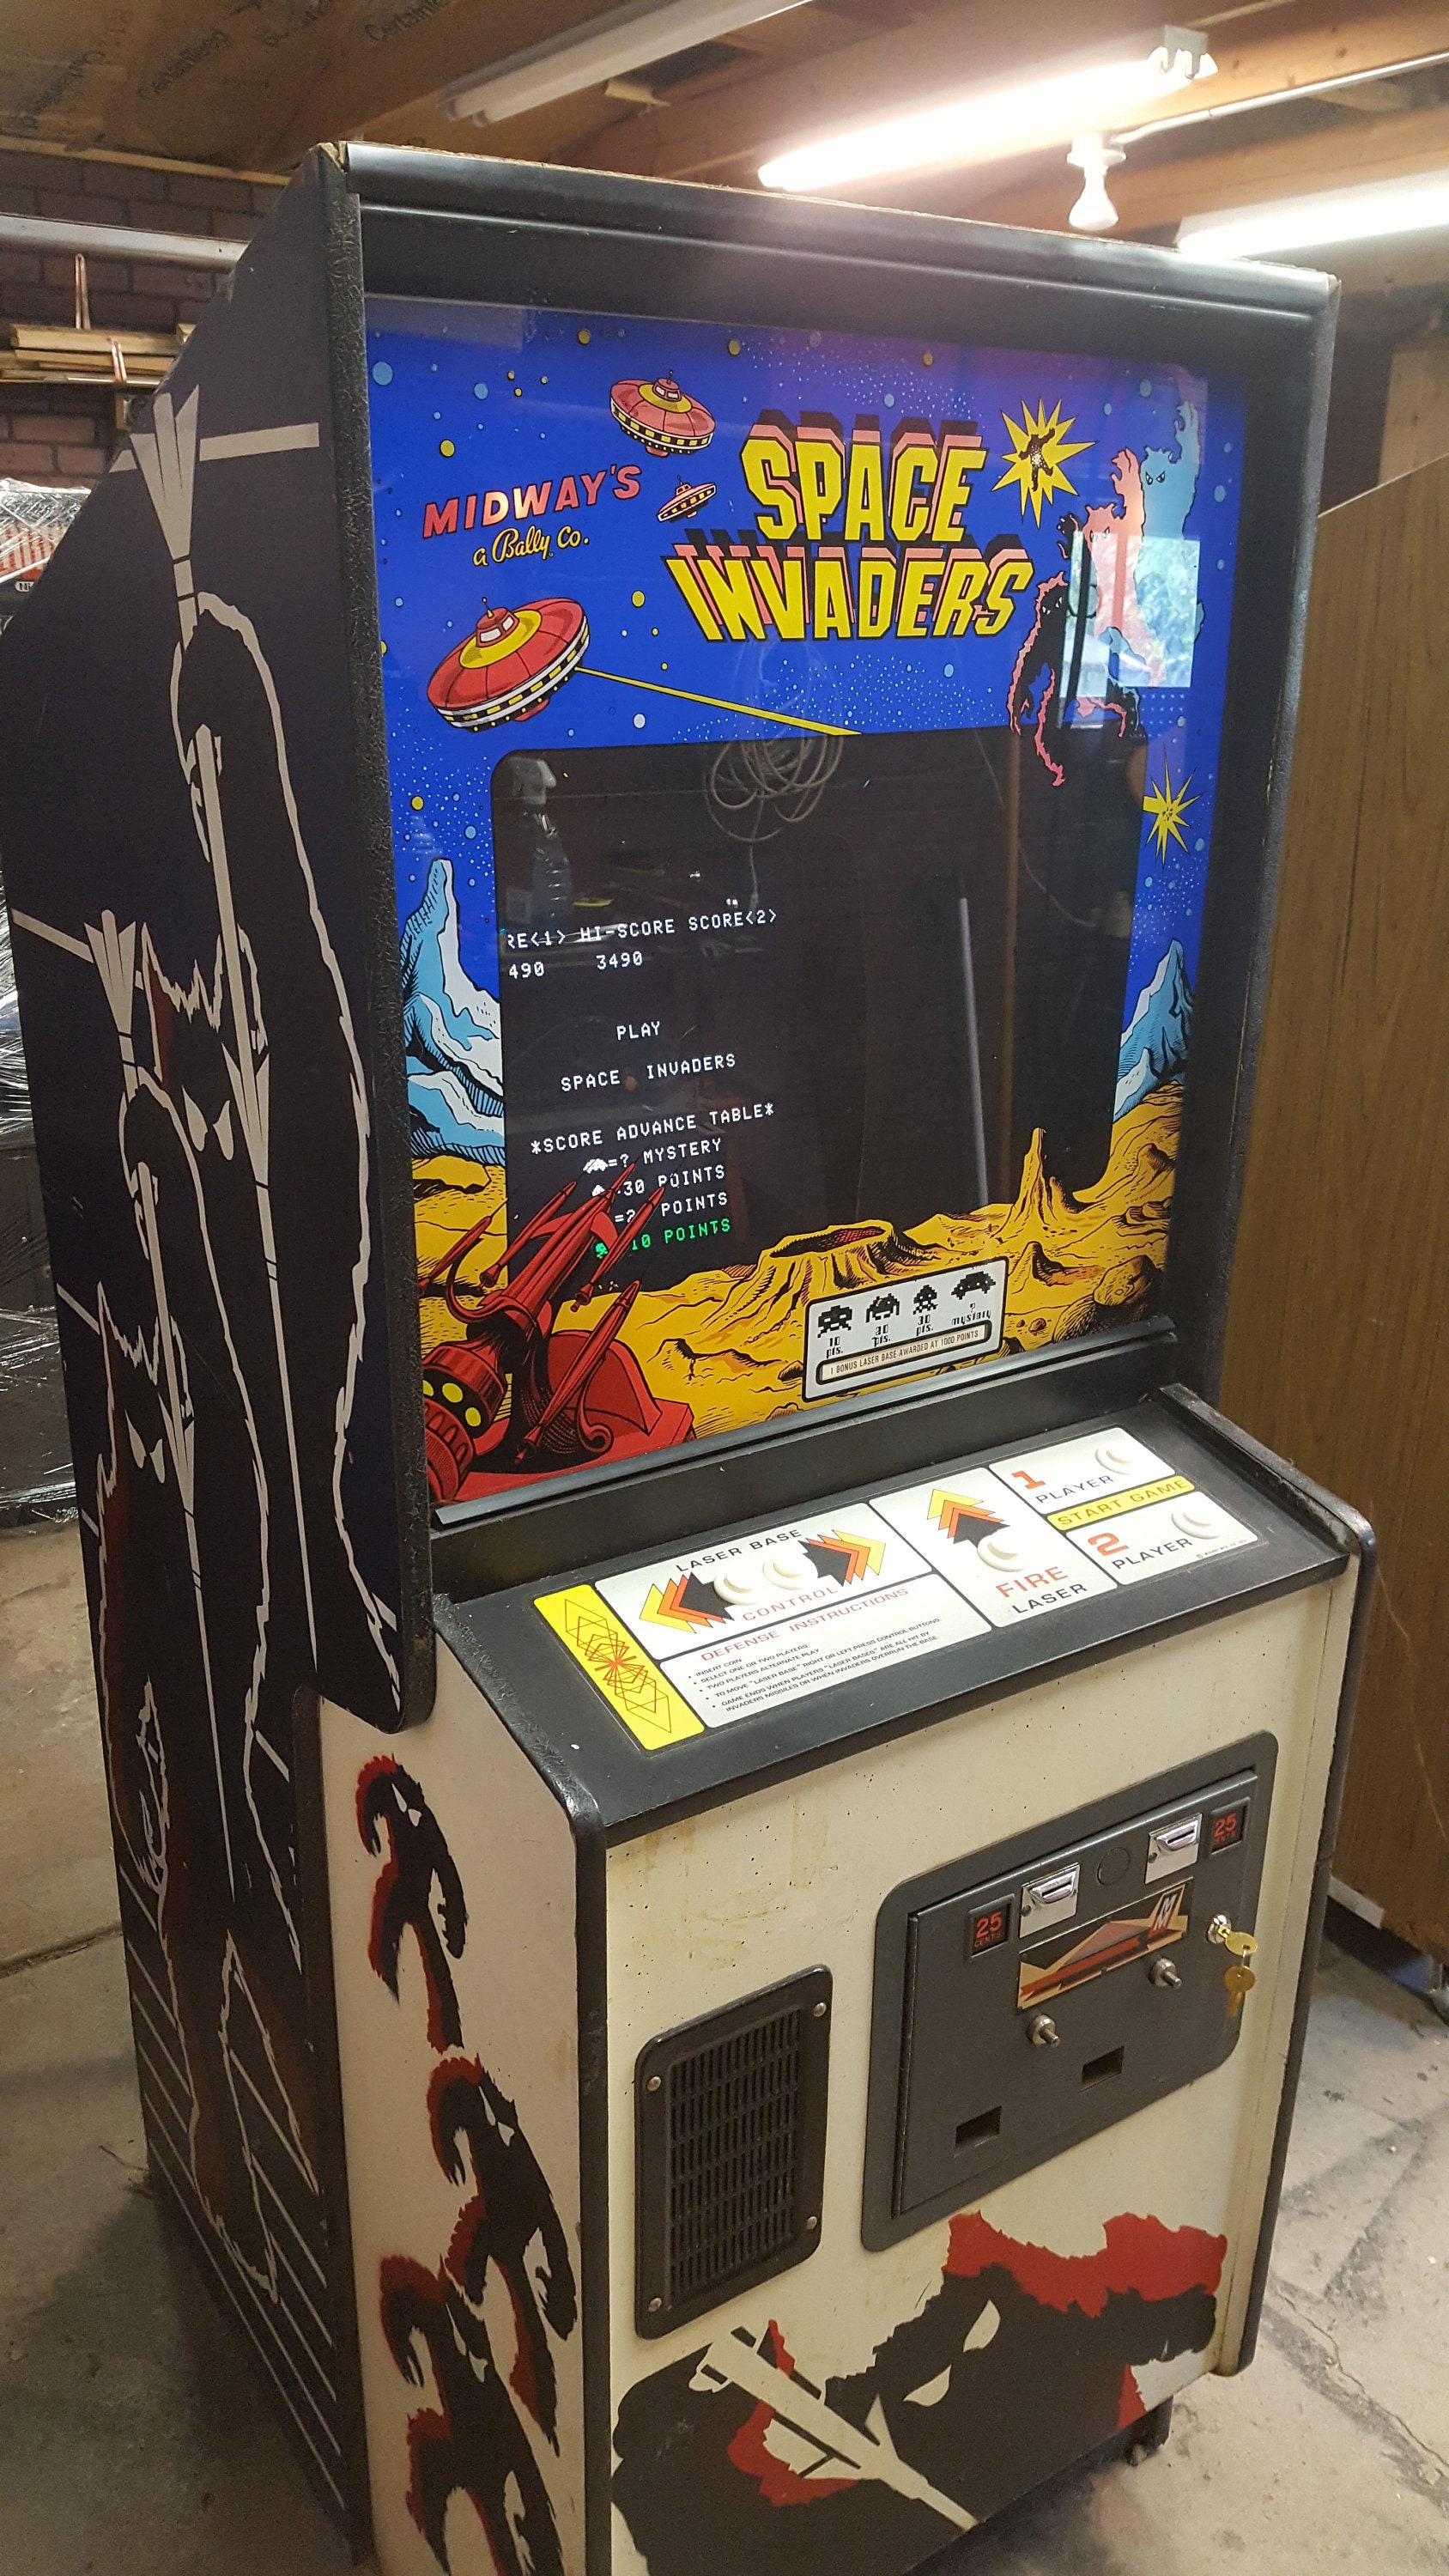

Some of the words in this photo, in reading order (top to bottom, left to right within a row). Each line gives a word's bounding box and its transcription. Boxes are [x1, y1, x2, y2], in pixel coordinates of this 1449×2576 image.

[739, 422, 990, 544] SPACE
[422, 464, 642, 538] MIDWAY'S
[473, 548, 488, 567] a
[492, 525, 551, 563] Bally
[557, 526, 590, 550] Co.
[664, 544, 1035, 642] INVADERS
[580, 919, 675, 942] HI-SCORE
[688, 908, 777, 932] SCORE<2>
[509, 961, 545, 980] 490
[596, 951, 643, 970] 3490
[616, 1021, 660, 1041] PLAY
[561, 1070, 621, 1092] SPACE
[646, 1054, 736, 1079] INVADERS
[616, 1115, 696, 1141] ADVANCE
[643, 1138, 722, 1164] MYSTERY
[658, 1164, 724, 1188] POINTS
[661, 1191, 728, 1217] POINTS
[664, 1218, 731, 1244] POINTS
[836, 1360, 858, 1374] BONUS
[859, 1355, 879, 1367] LASER
[881, 1350, 897, 1362] BASE
[899, 1342, 929, 1358] AWARDED
[930, 1340, 938, 1349] AT
[941, 1336, 955, 1347] 1000
[956, 1330, 979, 1342] POINTS
[1011, 1470, 1046, 1490] 1
[1035, 1475, 1114, 1504] PLAYER
[1058, 1499, 1123, 1526] START
[1130, 1479, 1187, 1503] GAME
[676, 1547, 743, 1572] LASER
[749, 1529, 803, 1550] BASE
[1088, 1532, 1130, 1557] 2
[1112, 1537, 1193, 1570] PLAYER
[996, 1565, 1069, 1598] FIRE
[1011, 1583, 1088, 1613] LASER
[743, 1587, 839, 1621] CONTROL
[700, 1631, 780, 1662] DEFENSE
[789, 1589, 909, 1631] INSTRUCTIONS
[695, 1664, 722, 1677] INSERT
[724, 1658, 743, 1668] COIN
[700, 1672, 728, 1683] SELECT
[758, 1655, 775, 1664] TWO
[706, 1680, 725, 1690] TWO
[727, 1669, 760, 1684] PLAYERS
[761, 1656, 801, 1672] ALTERNATE
[801, 1649, 820, 1659] PLAY
[727, 1684, 749, 1694] MOVE
[803, 1656, 824, 1668] RIGHT
[876, 1629, 909, 1642] CONTROL
[721, 1696, 743, 1706] GAME
[744, 1687, 767, 1698] ENDS
[767, 1679, 791, 1691] WHEN
[791, 1667, 823, 1682] PLAYERS
[726, 1695, 764, 1712] INVADERS
[765, 1683, 799, 1698] MISSILES
[811, 1671, 834, 1683] WHEN
[835, 1659, 870, 1674] INVADERS
[871, 1646, 905, 1661] OVERRUN
[1214, 1813, 1237, 1838] 25
[974, 1933, 1003, 1948] CENTS
[976, 1911, 1003, 1939] 25
